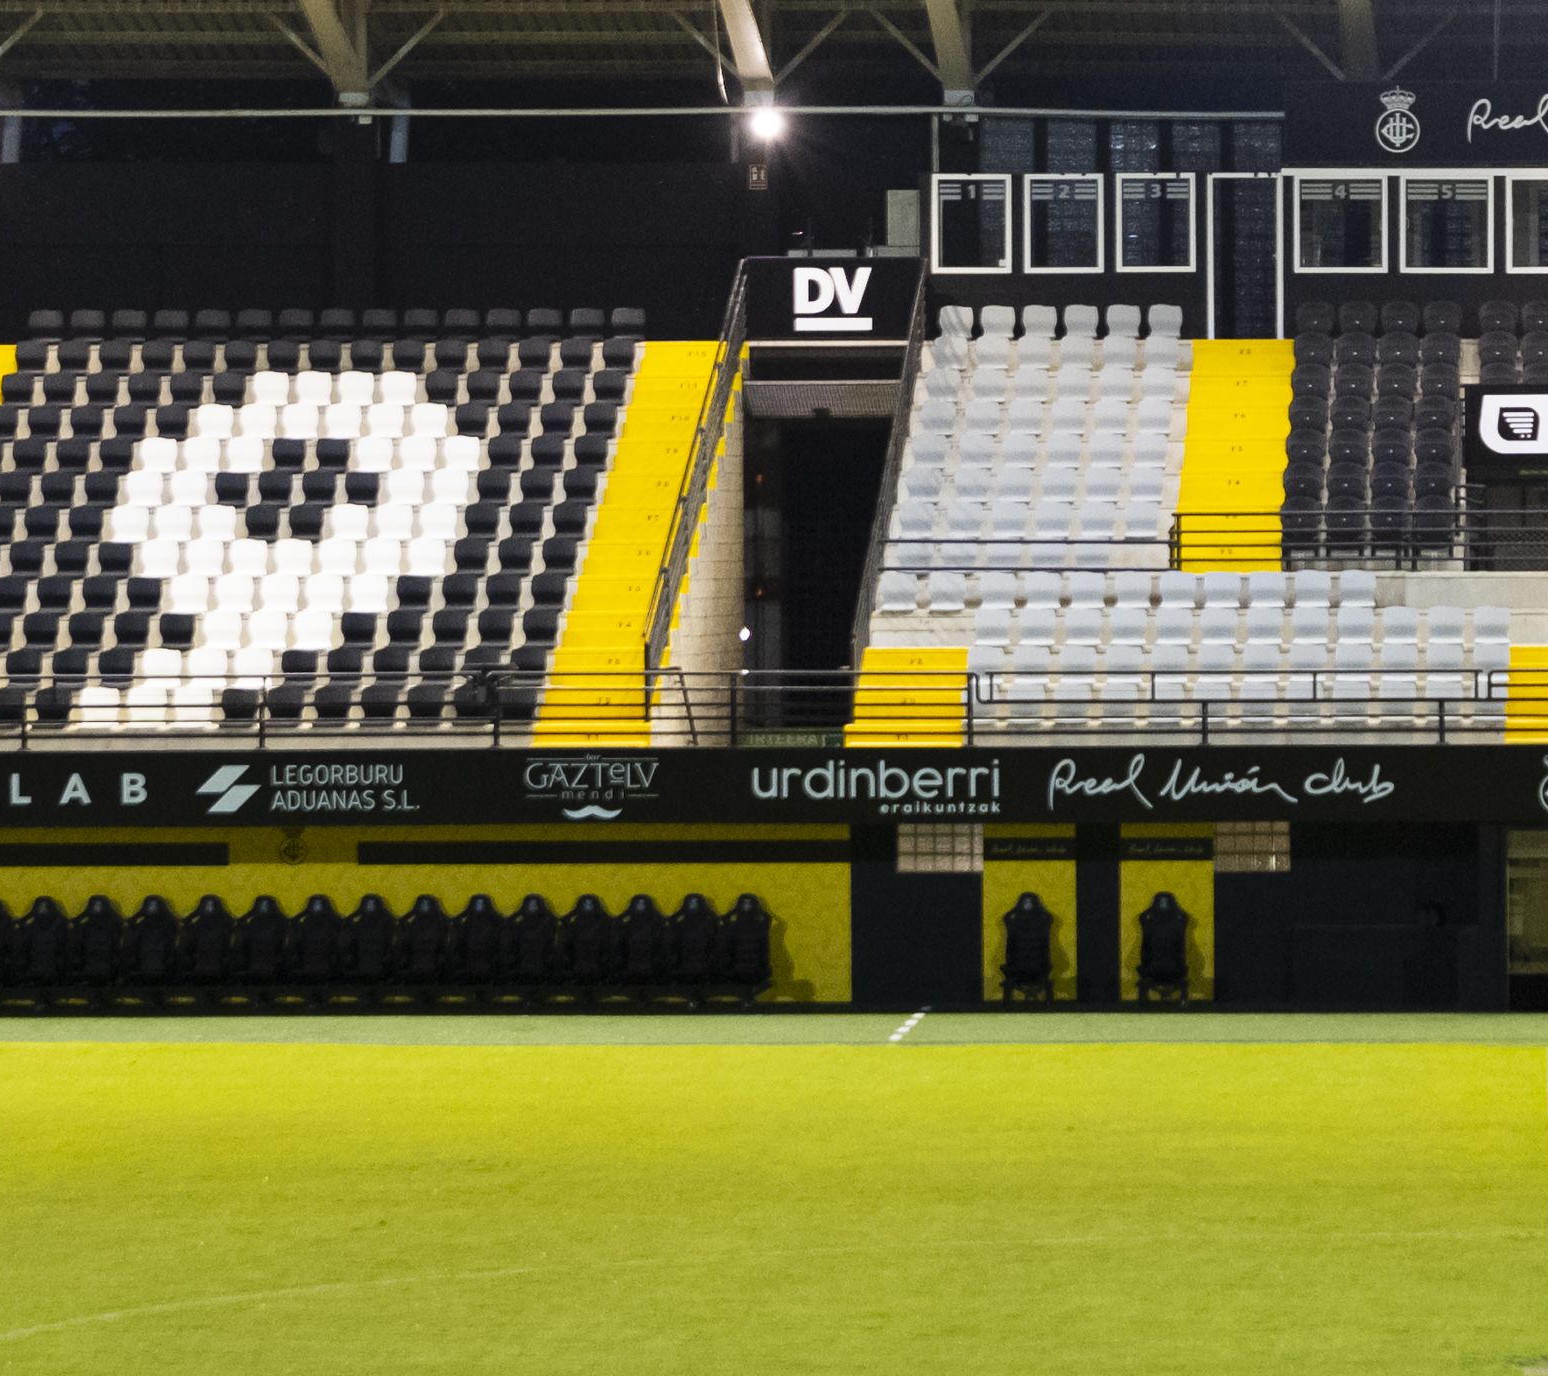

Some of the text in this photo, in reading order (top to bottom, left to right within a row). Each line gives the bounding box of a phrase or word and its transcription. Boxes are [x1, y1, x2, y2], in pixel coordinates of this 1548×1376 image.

[967, 185, 976, 199] 1
[1059, 184, 1070, 199] 2
[1150, 184, 1161, 198] 3
[1334, 185, 1347, 199] 4
[1442, 185, 1453, 199] 5
[794, 267, 872, 314] DV
[76, 372, 479, 731] 9
[272, 765, 402, 785] LEGORBURU
[752, 759, 999, 798] urdinberri
[1049, 754, 1153, 809] Real
[272, 790, 420, 810] ADUANAS S.L.
[562, 789, 624, 800] mendi
[880, 801, 1000, 813] eraikuntzak
